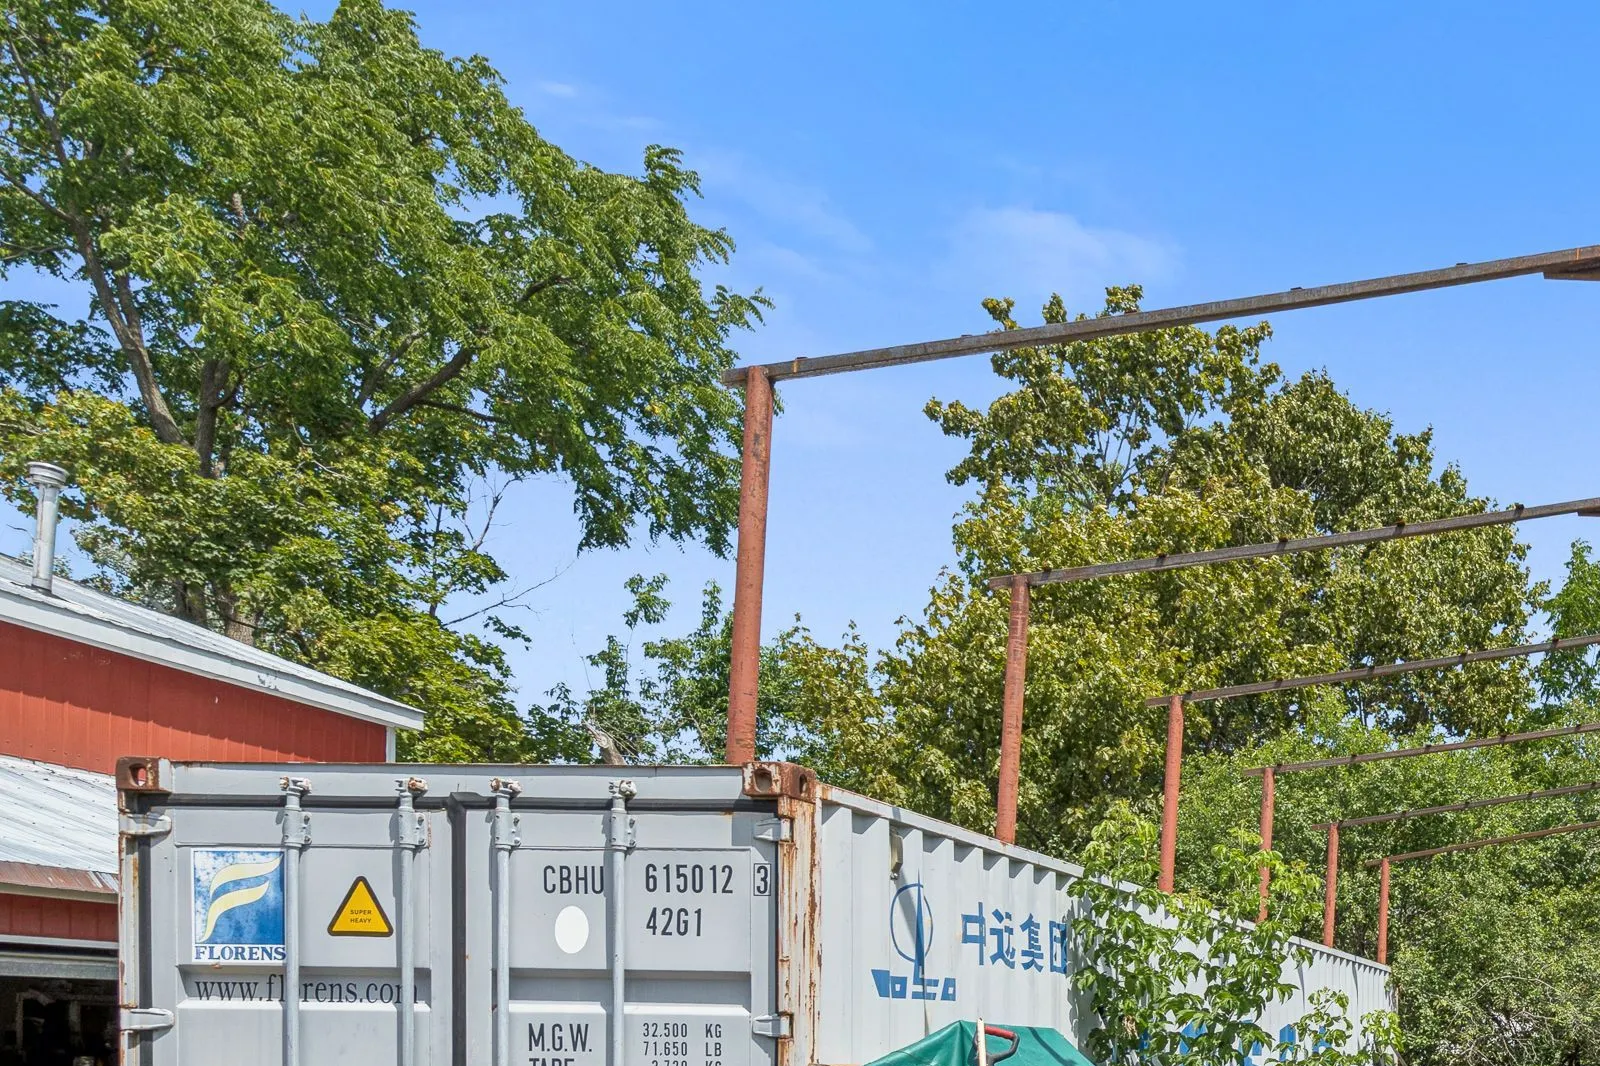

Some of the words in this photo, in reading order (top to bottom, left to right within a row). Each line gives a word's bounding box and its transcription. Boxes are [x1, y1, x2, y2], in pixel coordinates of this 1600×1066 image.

[543, 865, 604, 895] CBHU
[645, 863, 734, 894] 615012
[755, 865, 770, 895] 3
[645, 907, 703, 937] 42G1
[194, 946, 287, 962] FLORENS
[527, 1023, 593, 1053] M.G.W.
[705, 1023, 722, 1039] KG
[705, 1042, 722, 1057] LB
